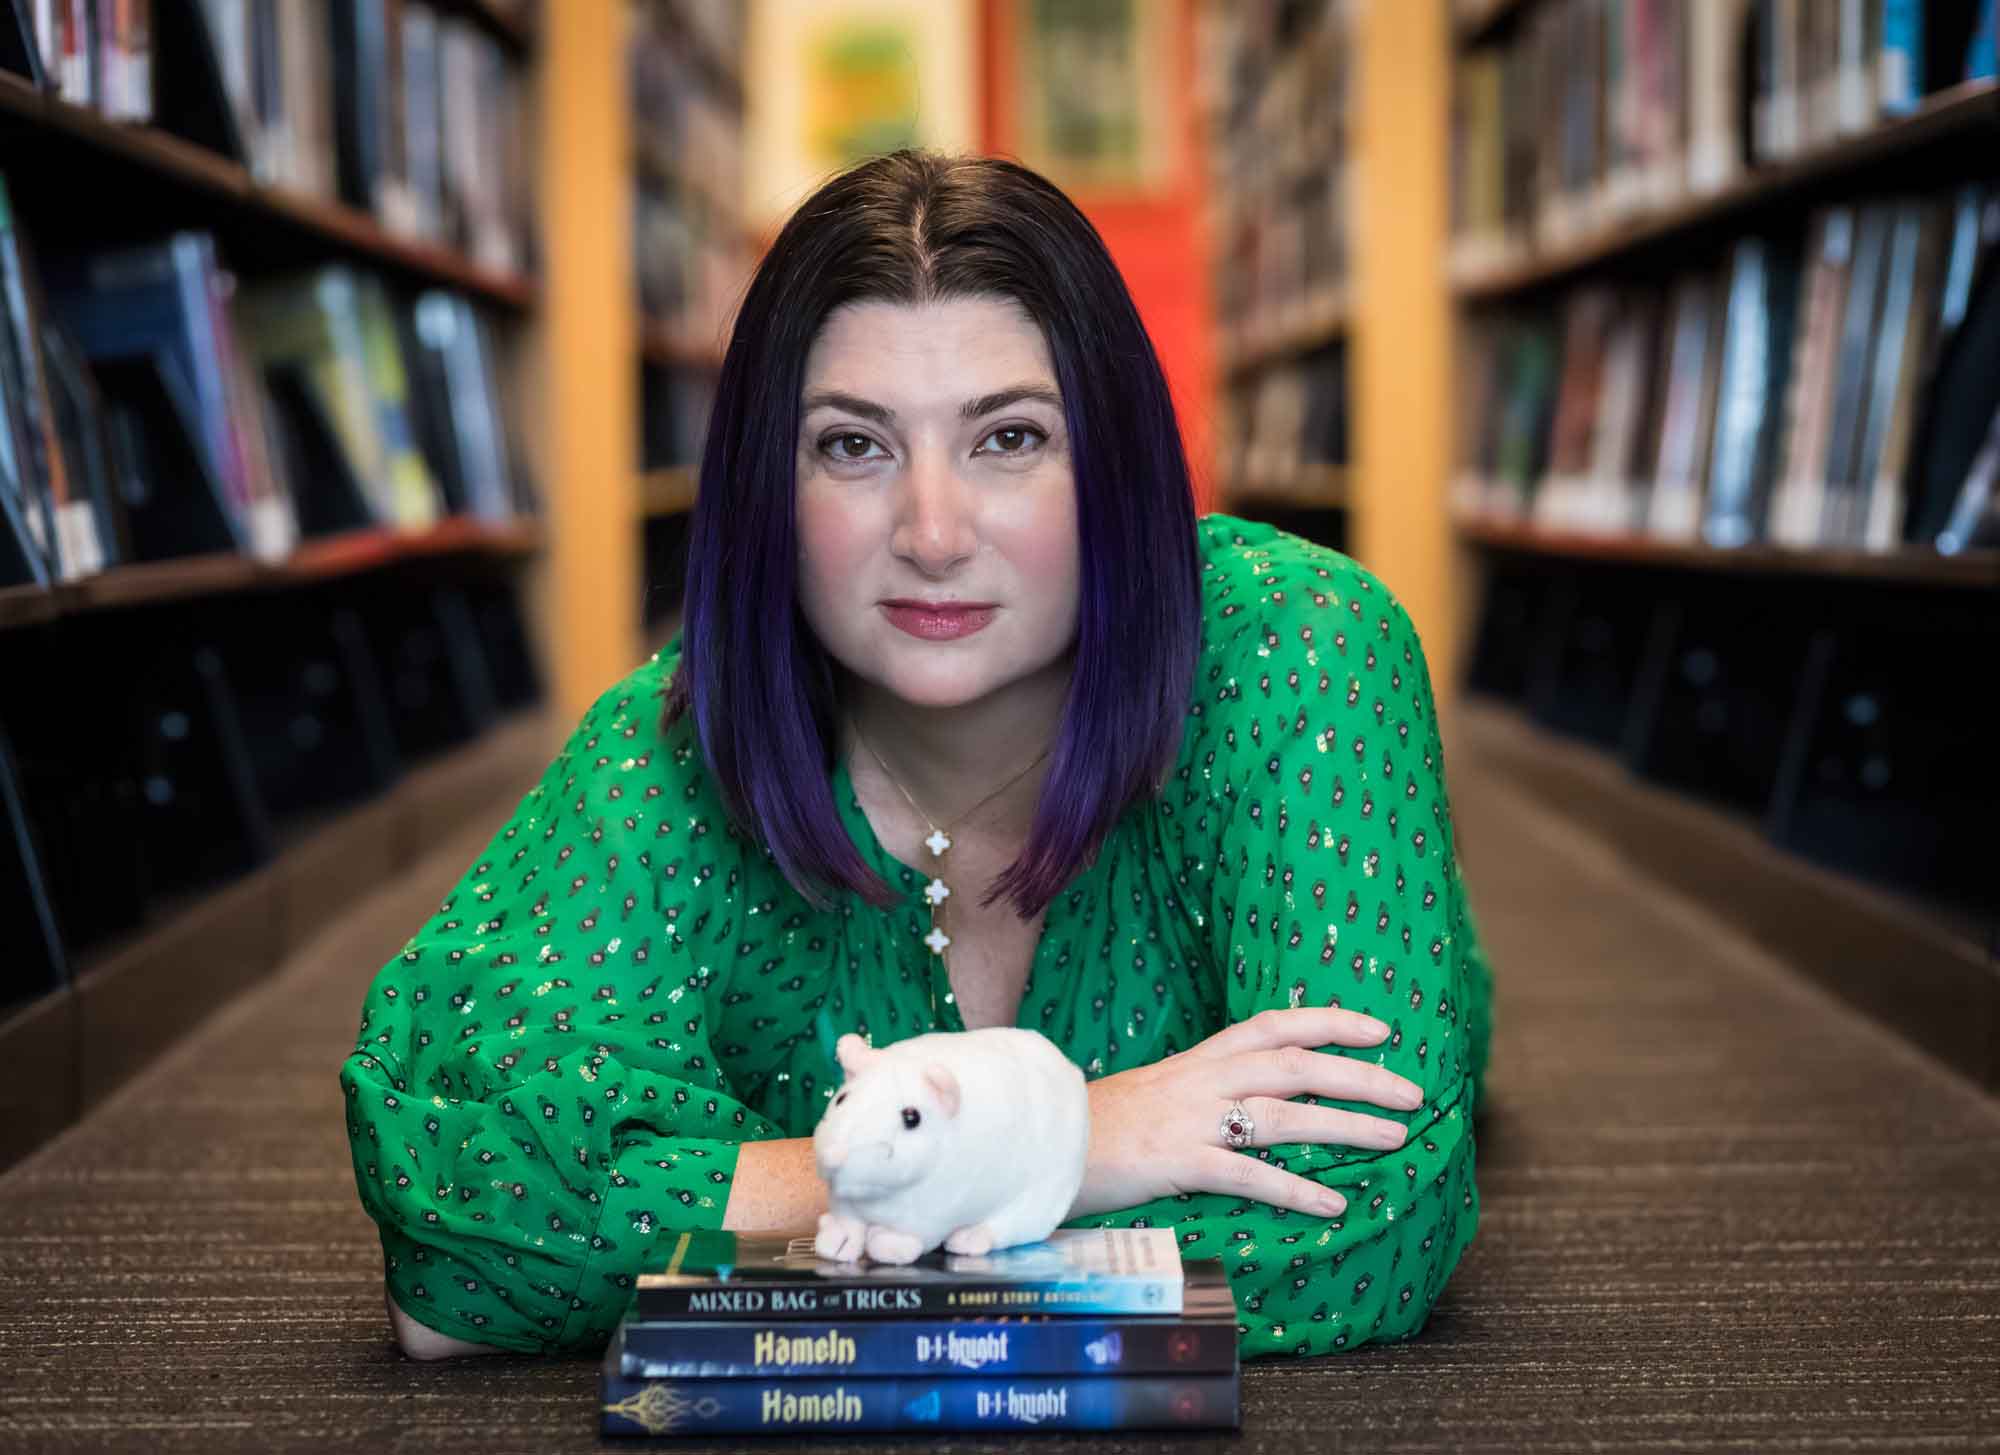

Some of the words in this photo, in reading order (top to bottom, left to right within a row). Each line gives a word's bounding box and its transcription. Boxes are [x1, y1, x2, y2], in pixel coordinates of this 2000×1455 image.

[688, 1291, 764, 1312] MIXED
[771, 1290, 817, 1312] BAG
[844, 1288, 922, 1310] TRICKS
[959, 1292, 998, 1305] SHORT
[1002, 1292, 1041, 1305] STORY
[754, 1329, 856, 1366] Hameln
[762, 1386, 863, 1423] Hameln
